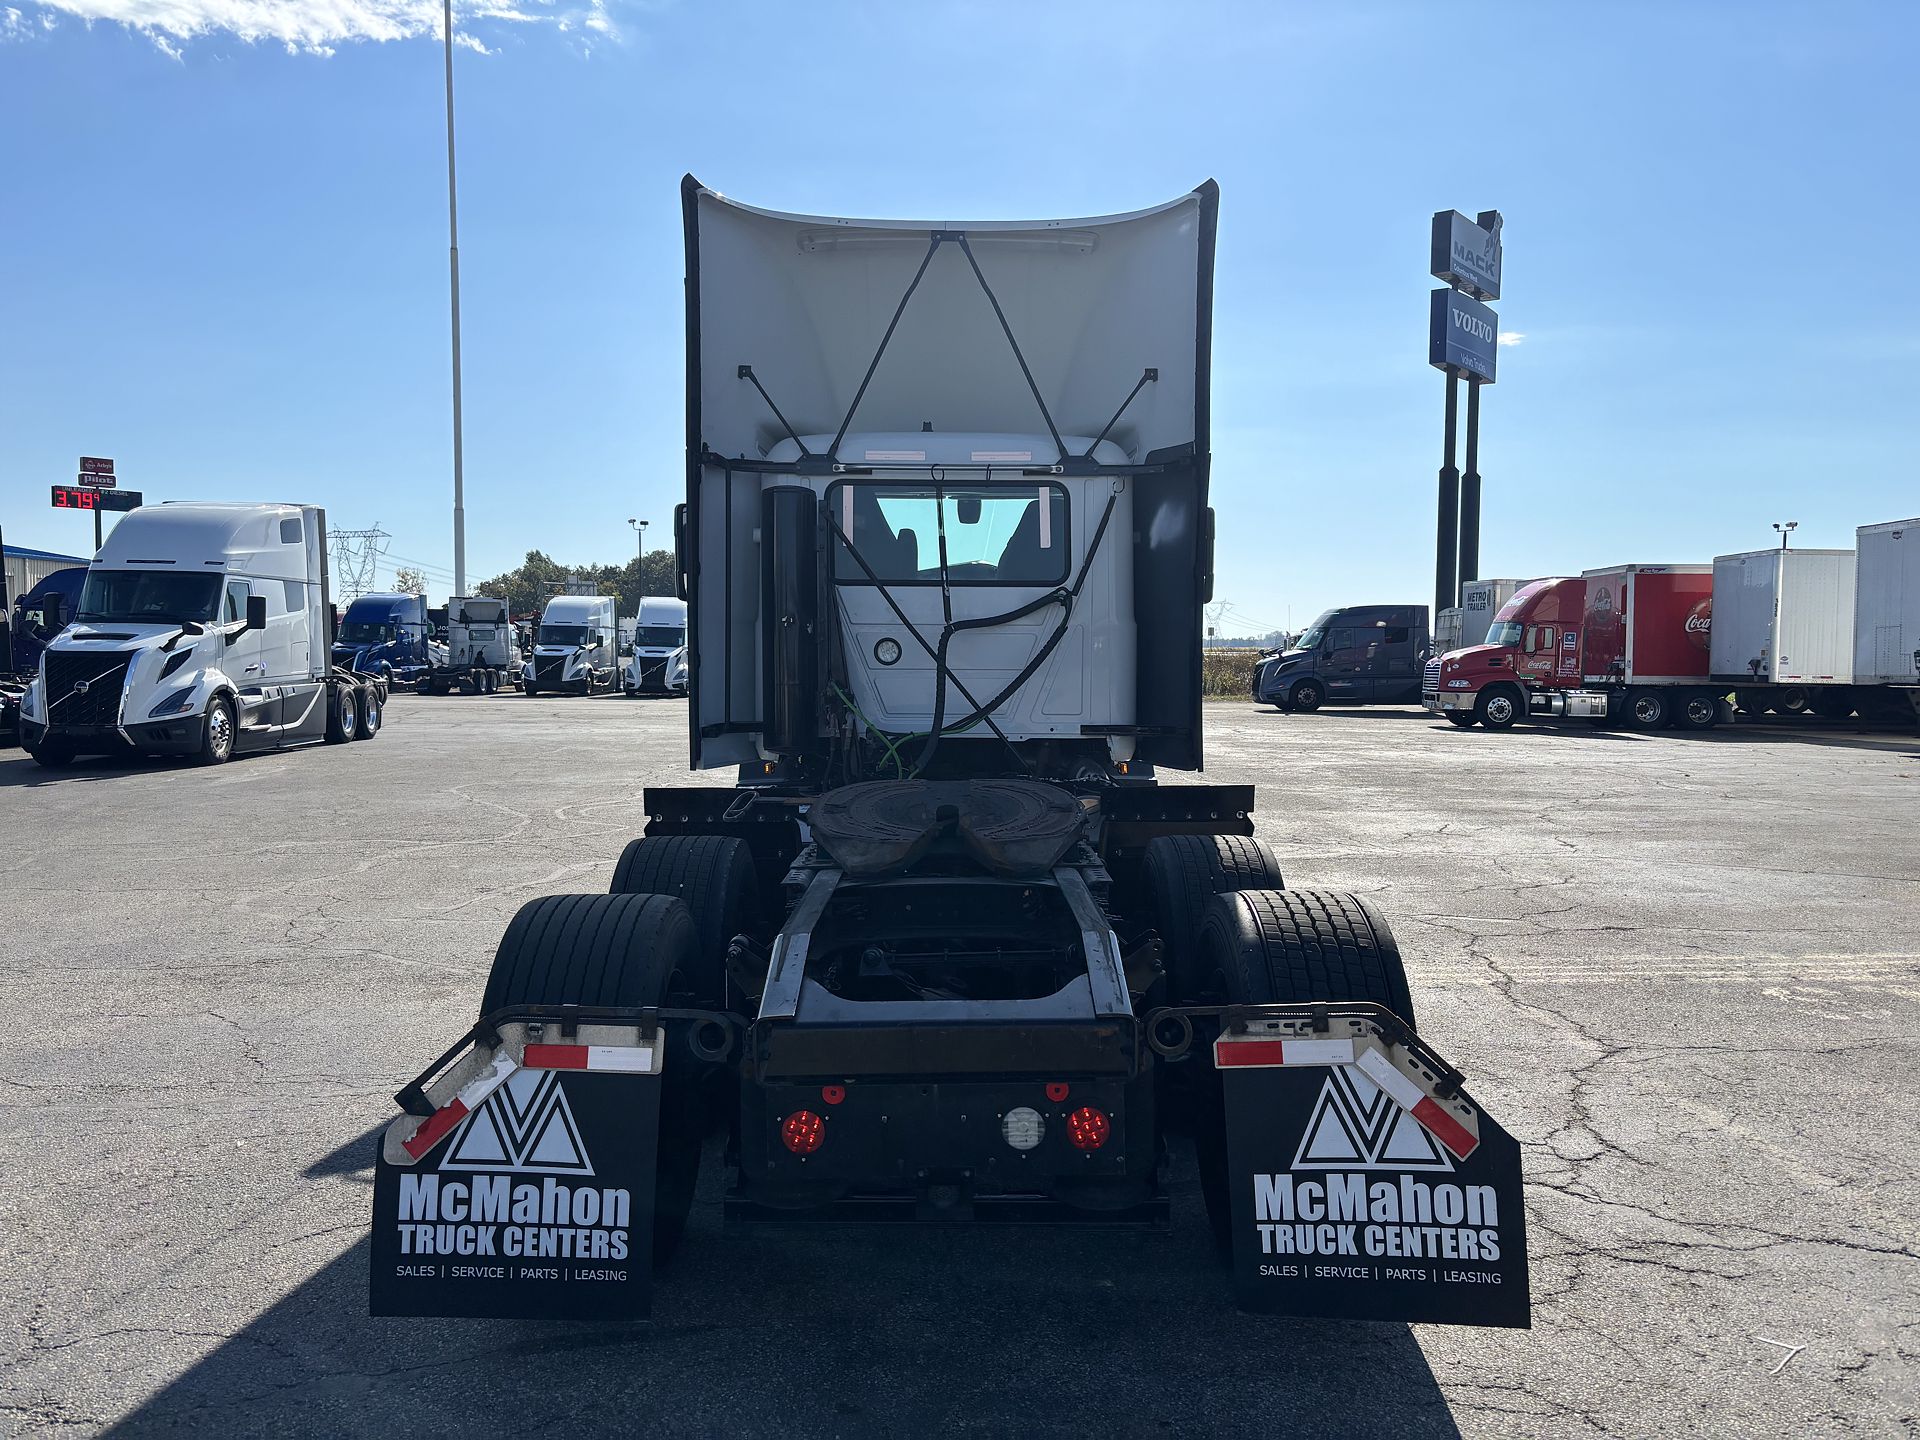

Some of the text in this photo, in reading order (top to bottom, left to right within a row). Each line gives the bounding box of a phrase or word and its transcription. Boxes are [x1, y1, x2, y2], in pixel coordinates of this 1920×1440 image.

[1454, 240, 1495, 277] MACK
[1453, 308, 1493, 343] VOLVO
[1467, 592, 1487, 602] METRO
[1467, 602, 1486, 612] TRAILER
[397, 1173, 631, 1228] McMahon
[1253, 1173, 1499, 1227] McMahon
[397, 1224, 629, 1260] TRUCK CENTERS
[1256, 1224, 1501, 1262] TRUCK CENTERS
[396, 1265, 628, 1282] SALES SERVICE PARTS LEASING
[1259, 1265, 1502, 1284] SALES SERVICE PARTS LEASING
